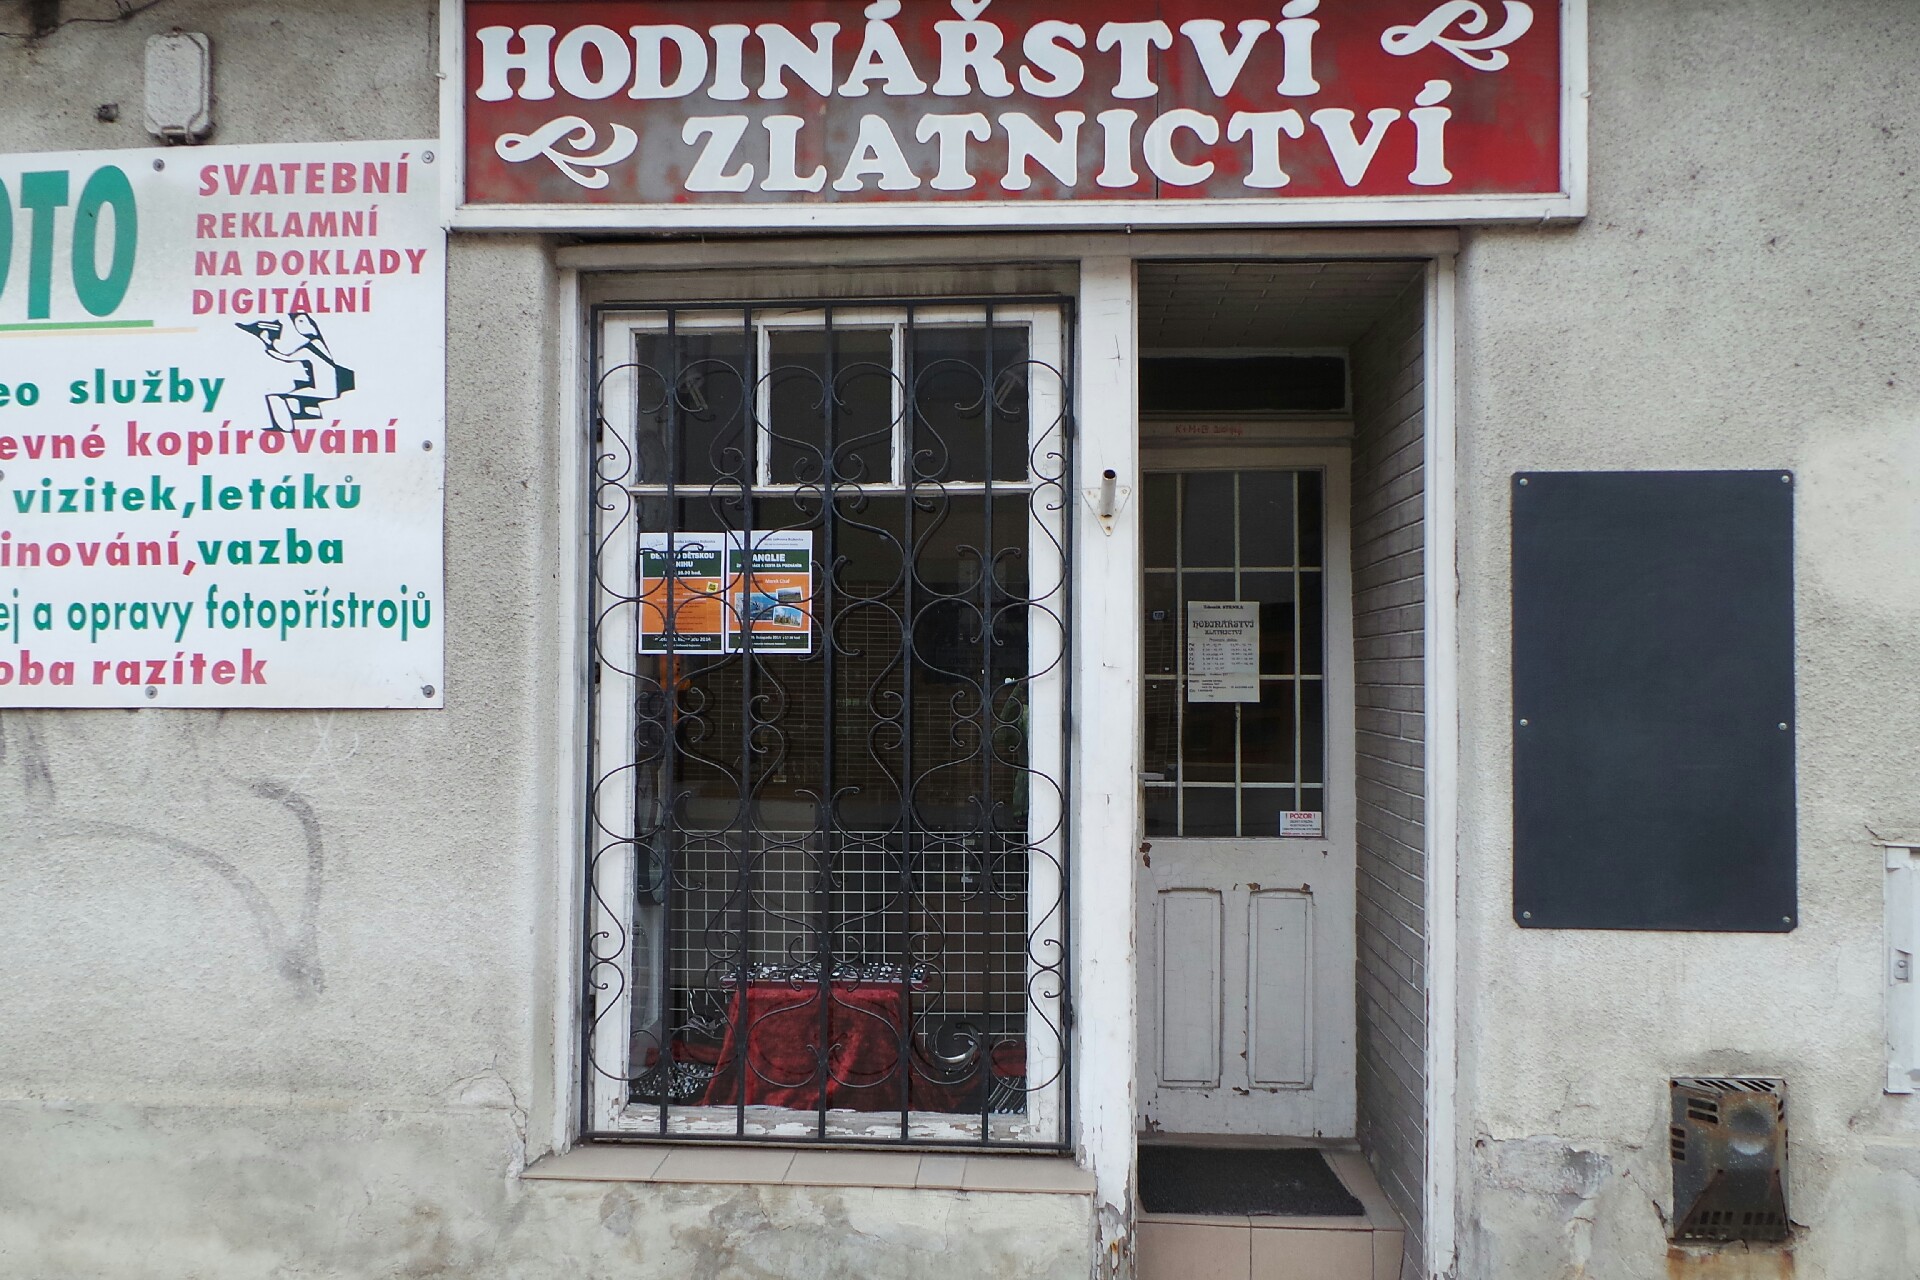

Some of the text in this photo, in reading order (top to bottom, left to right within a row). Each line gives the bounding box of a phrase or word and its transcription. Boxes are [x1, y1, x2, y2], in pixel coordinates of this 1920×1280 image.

[475, 0, 1320, 101] HODINÁŘSTVÍ
[681, 79, 1452, 192] ZLATNICTVÍ
[199, 152, 411, 197] SVATEBNÍ
[0, 164, 138, 320] TO
[195, 204, 379, 239] REKLAMNÍ
[194, 248, 428, 276] NA DOKLADY
[192, 280, 373, 315] DIGITÁLNÍ
[69, 367, 226, 413] služby
[127, 418, 399, 466] kopírování
[752, 553, 786, 562] ANGLIE
[33, 601, 53, 630] a
[67, 601, 194, 643] opravy
[205, 583, 431, 642] fotopřístrojů
[92, 648, 268, 686] razítek
